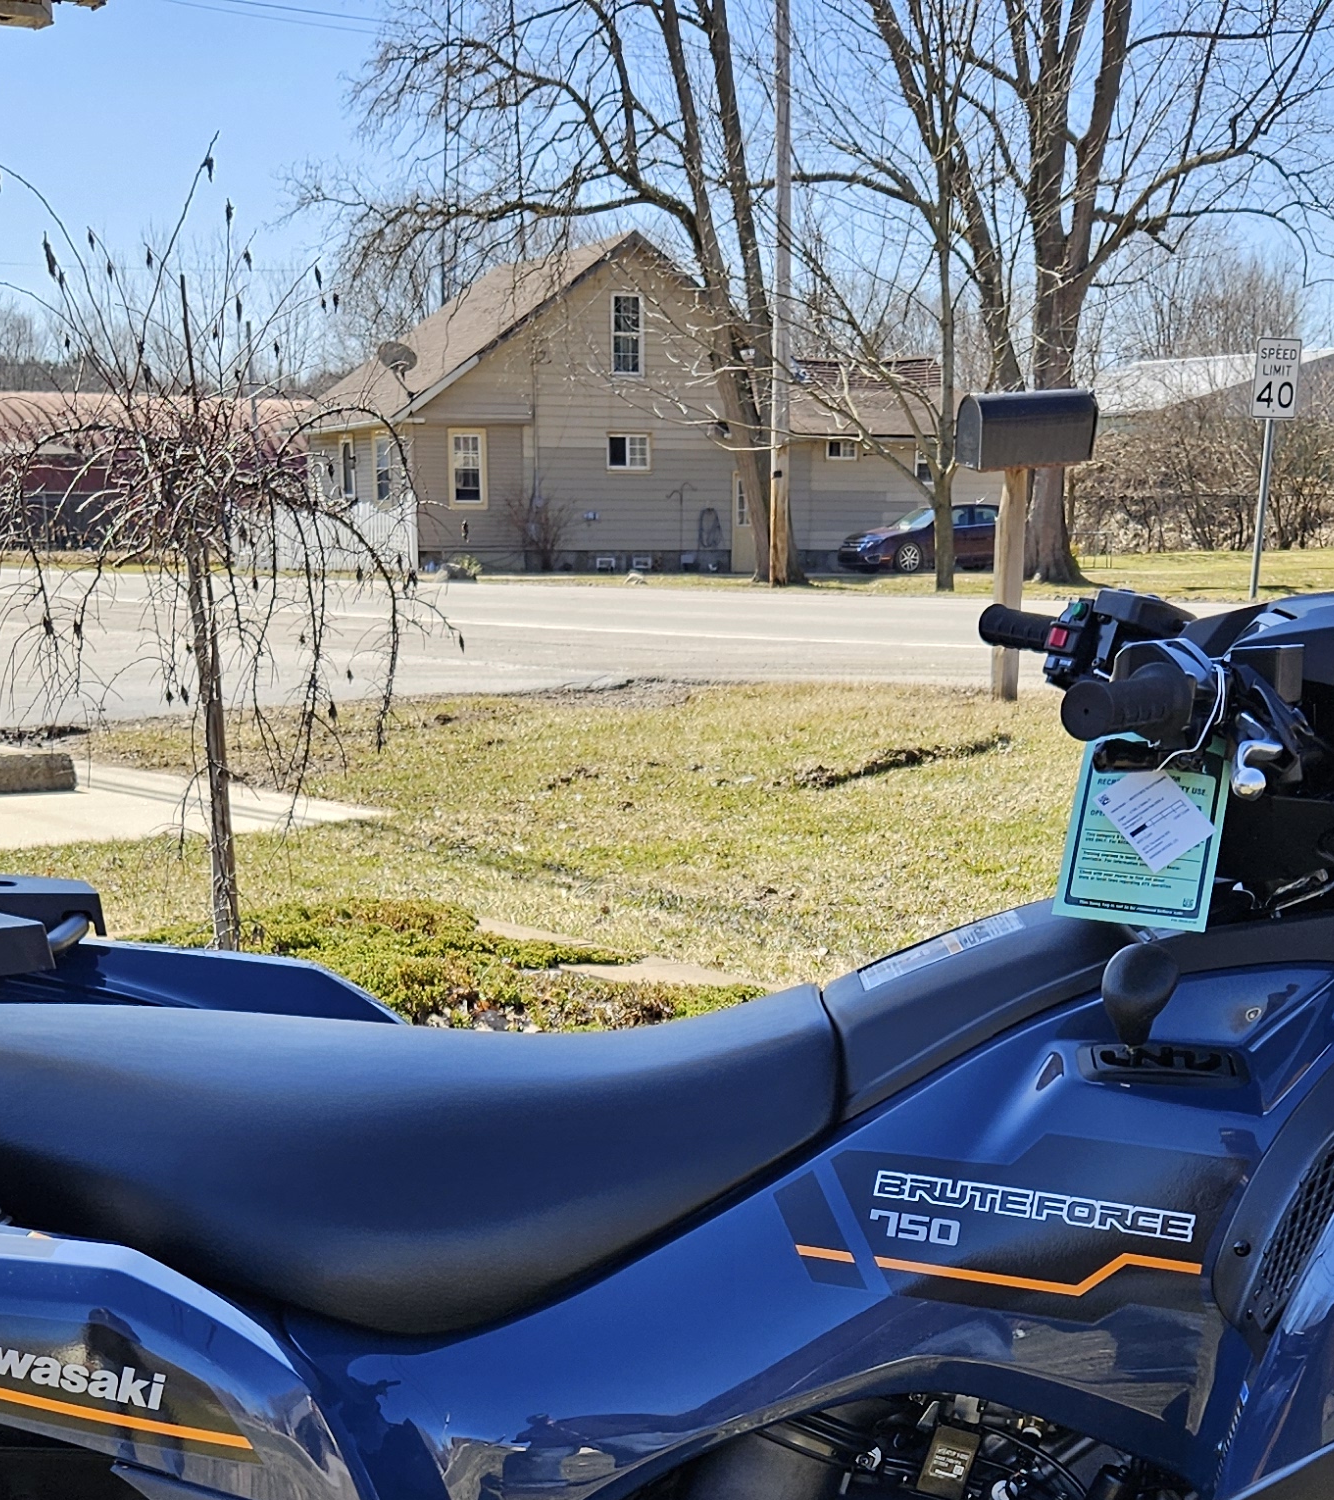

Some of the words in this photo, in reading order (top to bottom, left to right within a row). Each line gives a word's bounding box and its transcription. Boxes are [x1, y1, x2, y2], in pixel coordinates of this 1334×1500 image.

[1260, 347, 1297, 361] SPEED
[1262, 364, 1293, 376] LIMIT
[1256, 381, 1294, 409] 40
[873, 1170, 1036, 1219] BRUTE
[1032, 1193, 1196, 1242] FORCE
[869, 1208, 961, 1247] 750
